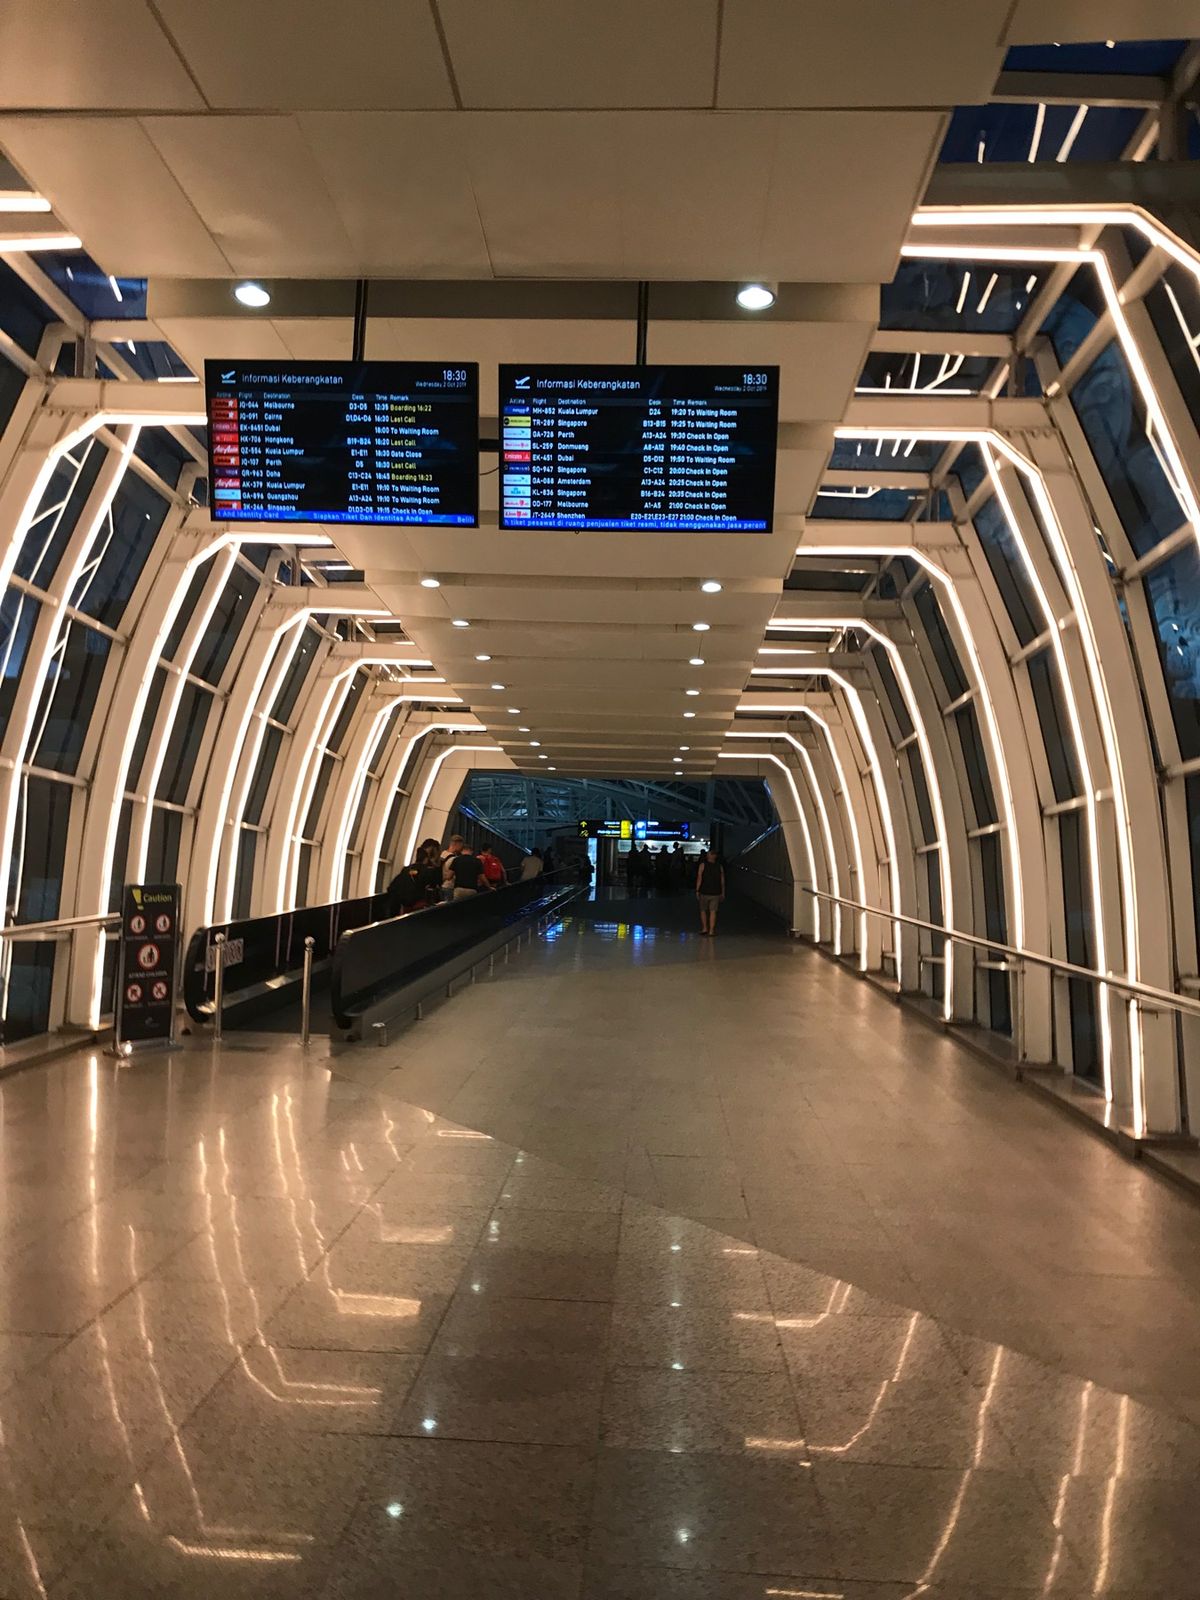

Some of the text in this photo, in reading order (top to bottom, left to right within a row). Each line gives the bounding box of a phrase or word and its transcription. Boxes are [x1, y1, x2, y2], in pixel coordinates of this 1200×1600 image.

[242, 370, 466, 385] Informasi Keberangkatan 18:30
[537, 374, 767, 390] Informasi Keberangkatan 18:30
[390, 404, 416, 412] Boarding
[264, 413, 282, 421] Cairns
[264, 424, 280, 432] Dubai
[399, 428, 421, 436] Waiting
[265, 436, 294, 445] Hongkong
[714, 433, 729, 441] Open
[283, 448, 304, 456] Lumpur
[558, 443, 589, 451] Donmuang
[713, 445, 728, 453] Open
[558, 466, 587, 474] Singapore
[712, 468, 728, 476] Open
[400, 485, 422, 493] Waiting
[267, 493, 298, 501] Guangzhou
[400, 497, 422, 505] Waiting
[711, 503, 726, 511] Open
[143, 893, 172, 902] Caution
